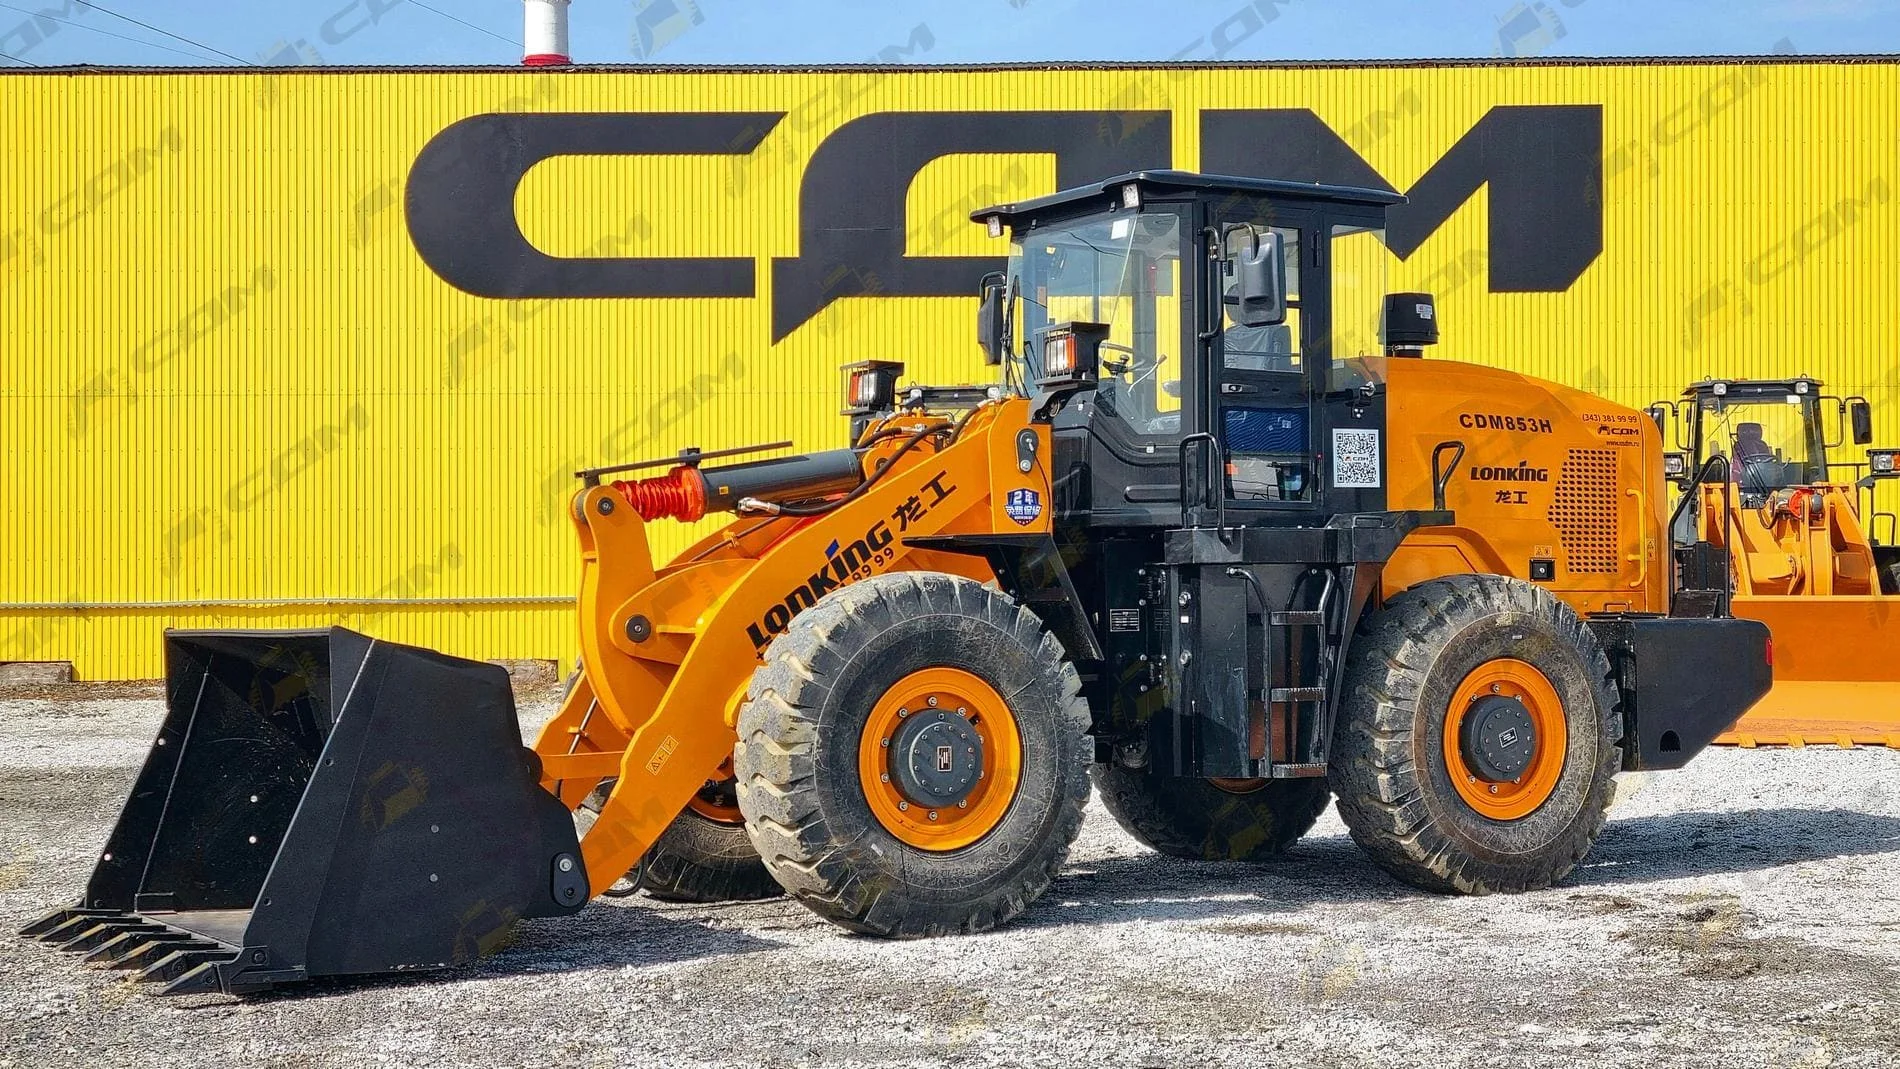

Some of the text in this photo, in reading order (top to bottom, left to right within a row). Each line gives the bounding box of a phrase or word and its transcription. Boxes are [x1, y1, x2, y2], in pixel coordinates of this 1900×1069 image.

[1459, 412, 1553, 434] CDM853H
[1582, 413, 1637, 423] (343) 381 99 99
[891, 470, 957, 532] 龙工
[1495, 490, 1528, 505] 龙工
[874, 547, 895, 567] 99
